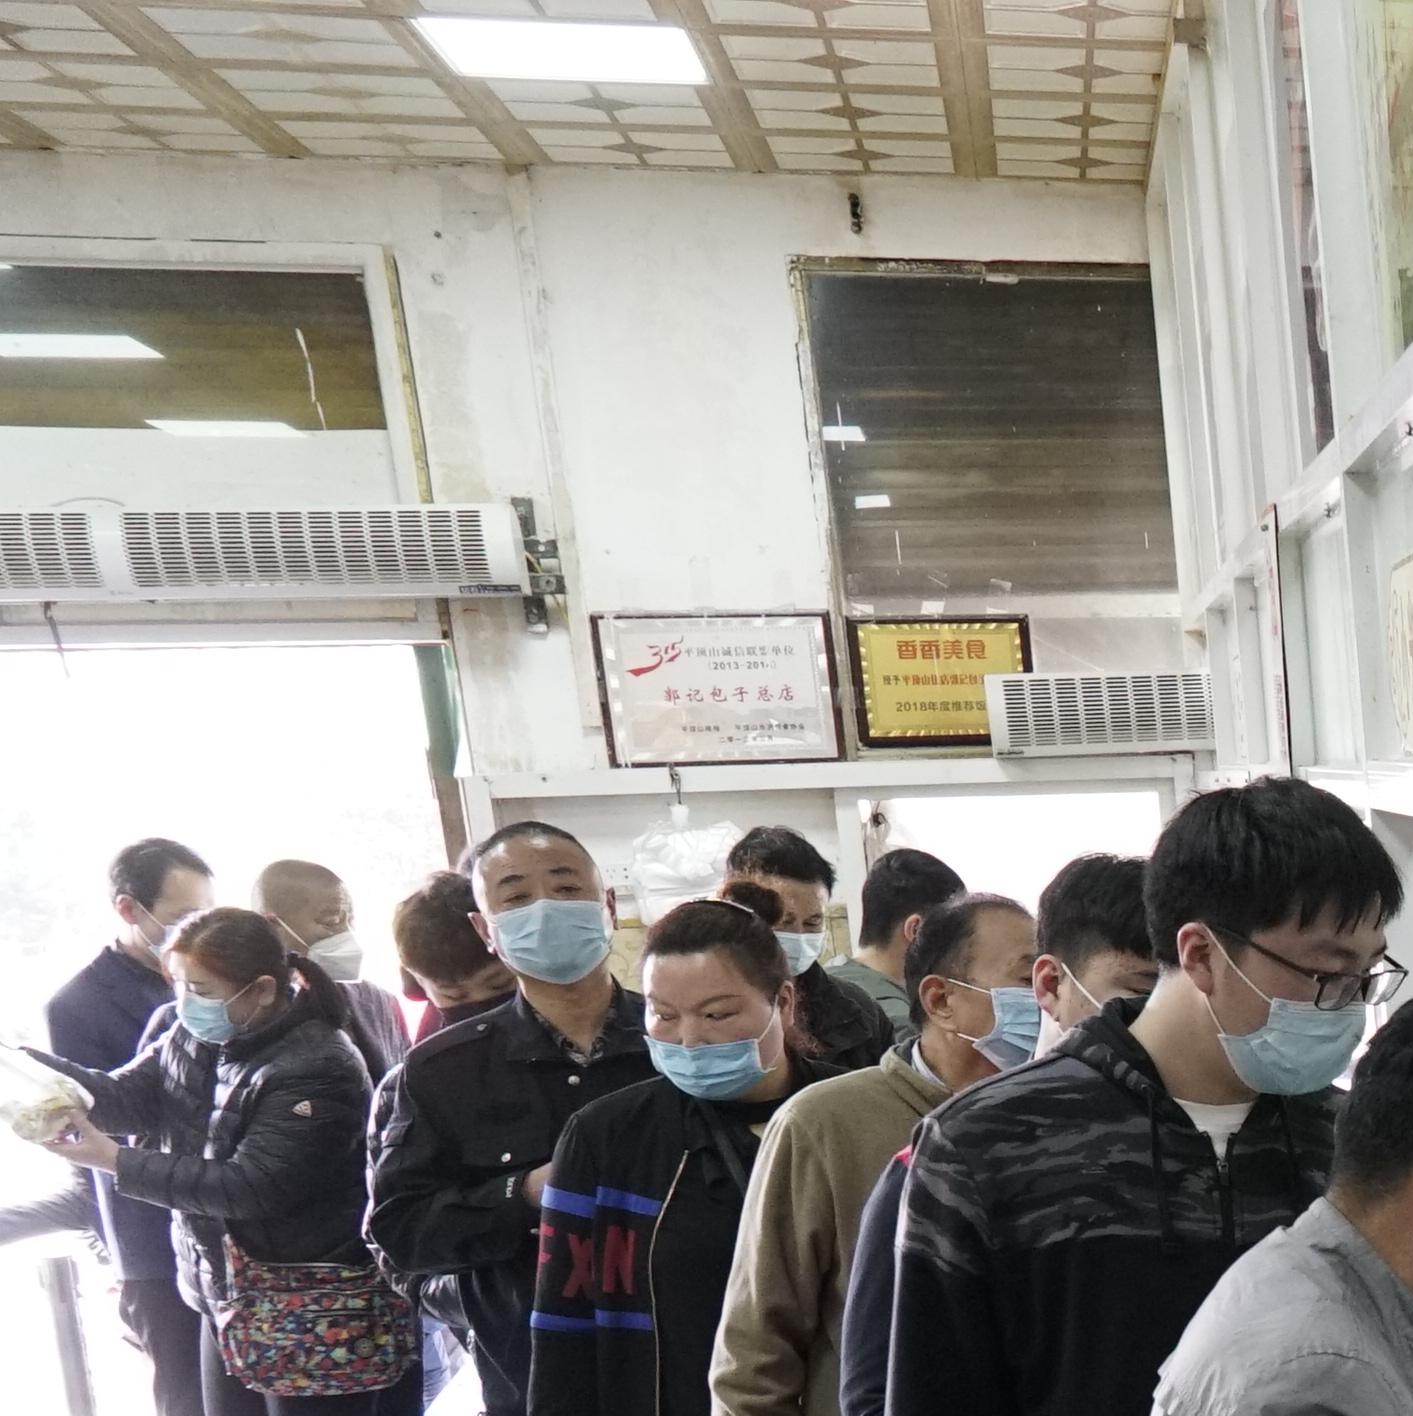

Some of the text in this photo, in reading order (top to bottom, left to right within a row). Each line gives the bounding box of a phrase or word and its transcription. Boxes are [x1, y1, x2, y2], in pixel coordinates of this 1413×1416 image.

[896, 639, 987, 660] 香香美食
[664, 684, 795, 705] 郭记包子总店
